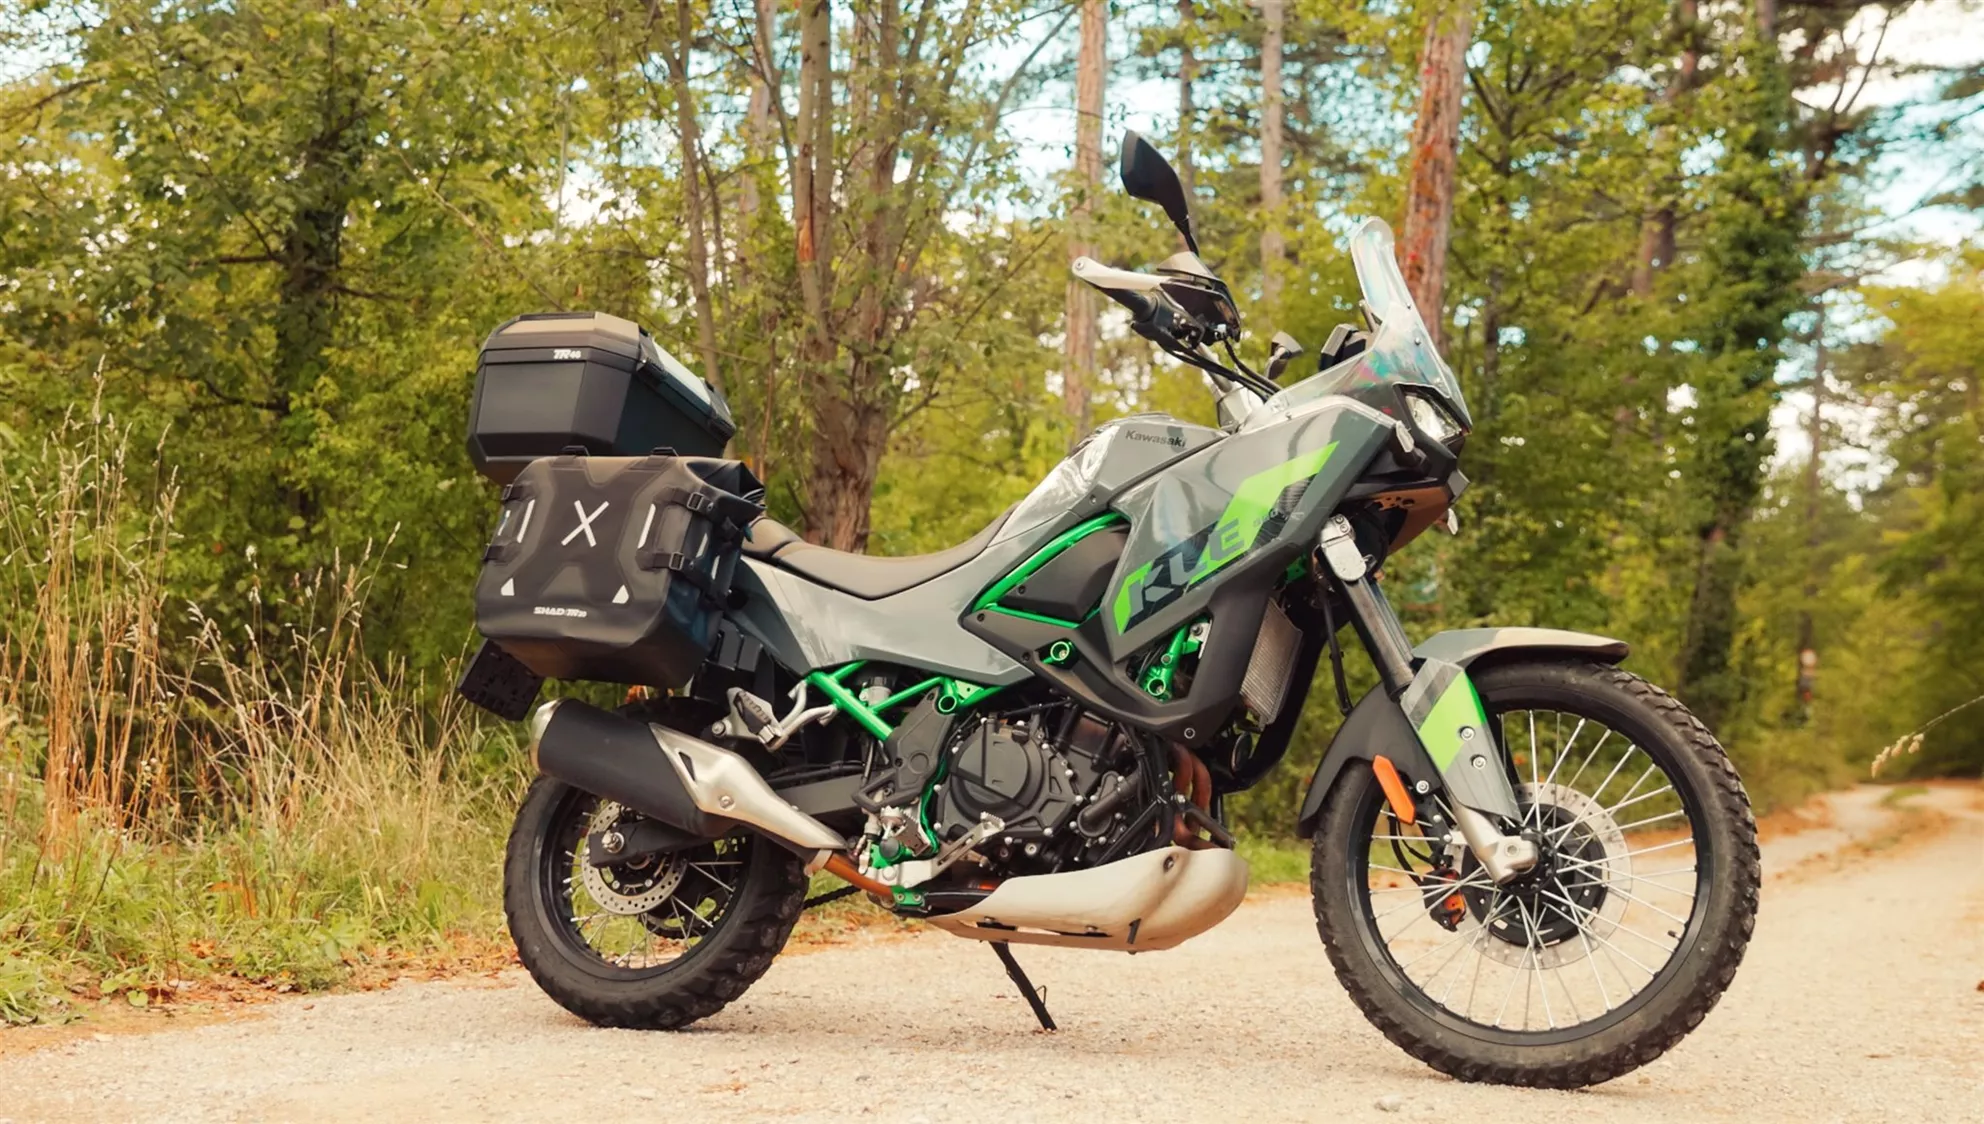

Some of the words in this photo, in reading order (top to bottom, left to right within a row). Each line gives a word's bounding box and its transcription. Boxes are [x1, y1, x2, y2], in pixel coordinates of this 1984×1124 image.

[1125, 429, 1186, 447] Kawasaki
[1127, 517, 1245, 618] KLE
[533, 606, 565, 616] SHAD
